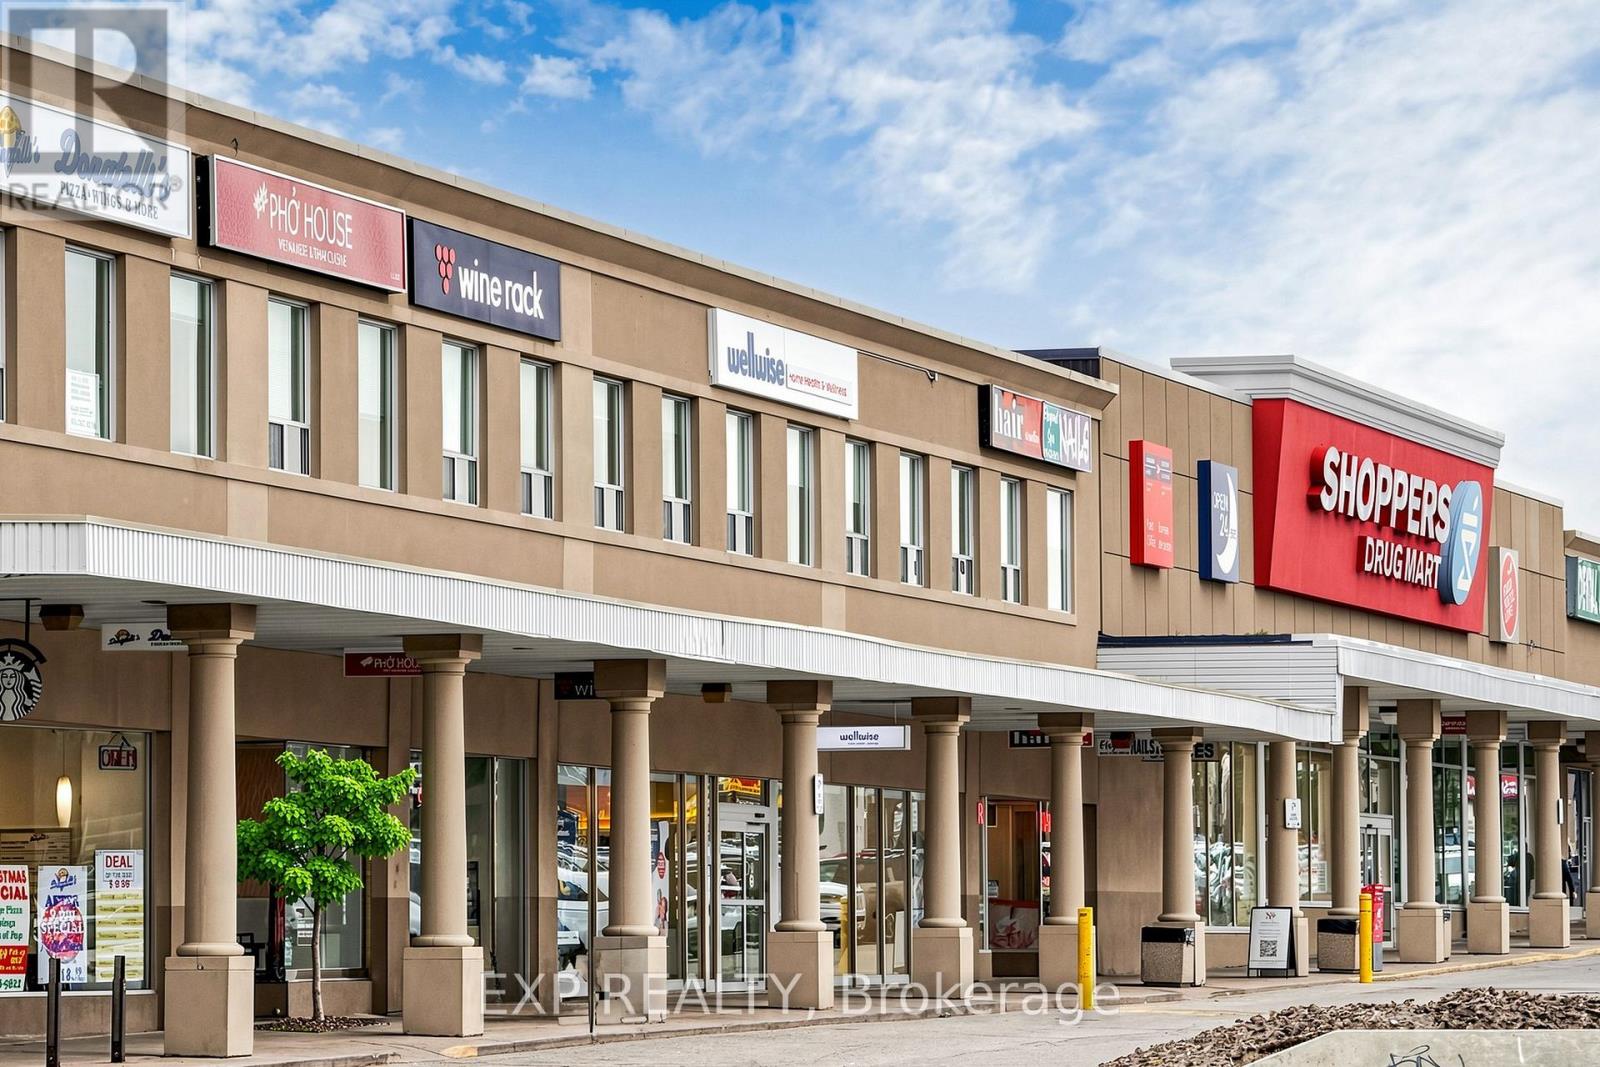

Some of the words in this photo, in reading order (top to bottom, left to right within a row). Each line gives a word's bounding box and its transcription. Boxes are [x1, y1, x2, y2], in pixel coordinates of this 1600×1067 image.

[60, 181, 87, 201] PIZZA
[134, 202, 159, 220] MORE
[304, 202, 353, 250] HOUSE
[458, 258, 502, 308] wine
[504, 270, 544, 320] rack
[727, 331, 785, 386] wellwise
[994, 392, 1024, 440] hair
[1320, 446, 1452, 544] SHOPPERS
[1364, 535, 1403, 580] DRUG
[1404, 546, 1442, 590] MART
[840, 730, 879, 741] wellwise
[105, 856, 132, 868] DEAL
